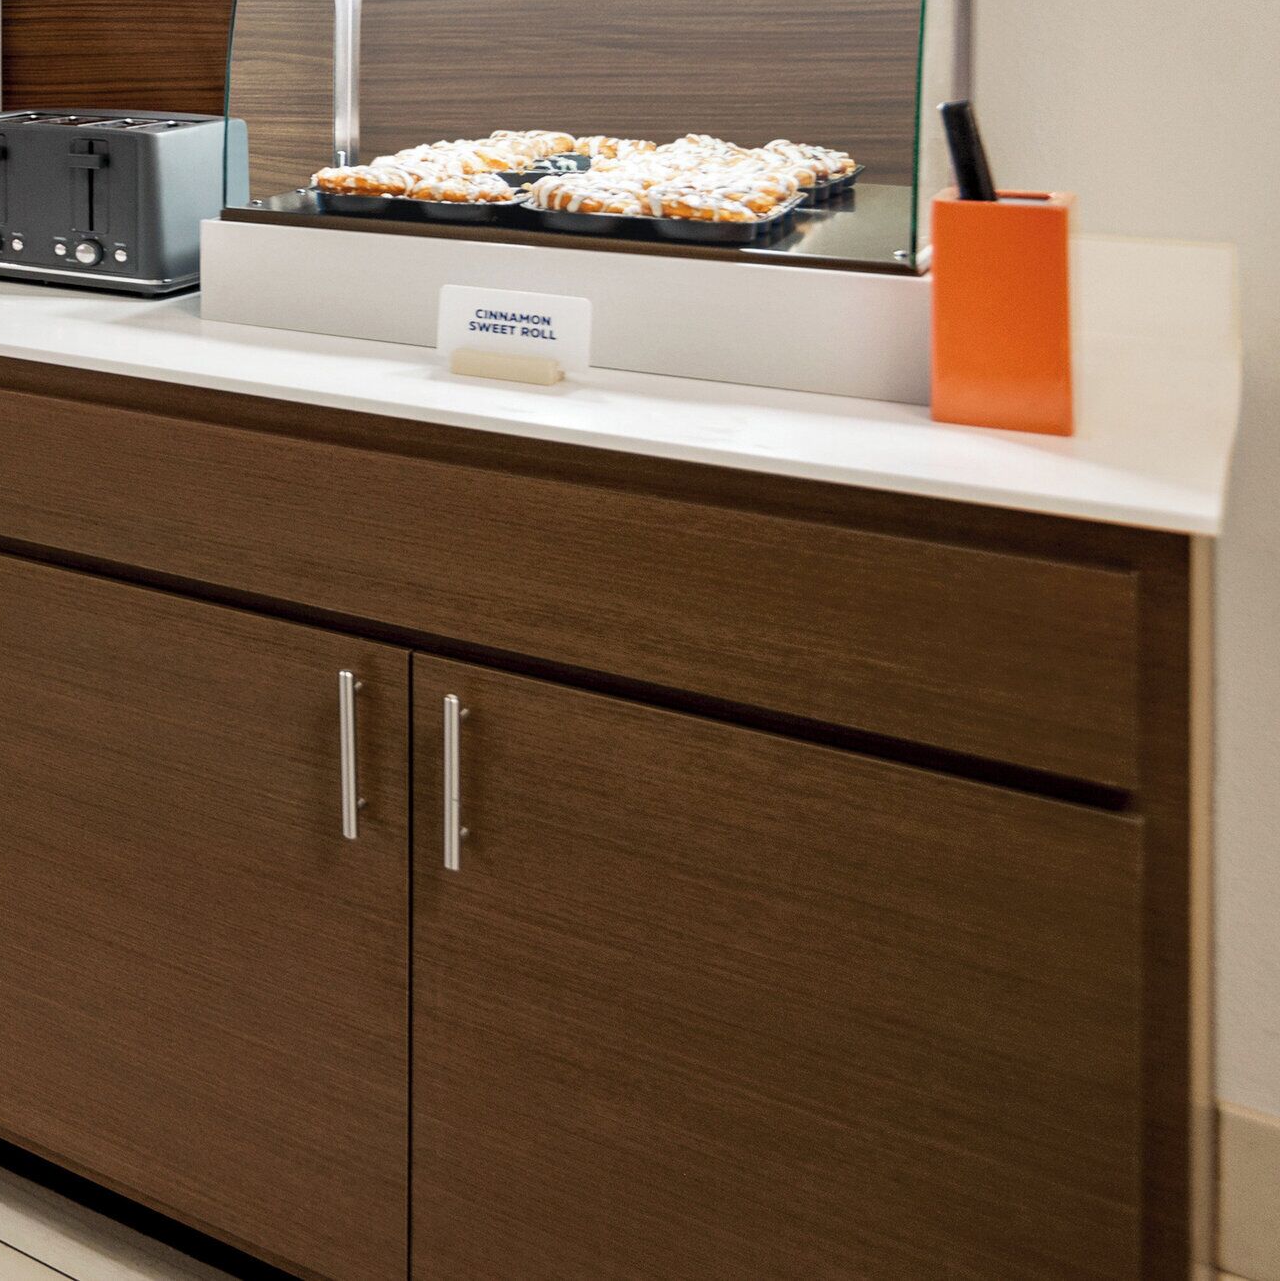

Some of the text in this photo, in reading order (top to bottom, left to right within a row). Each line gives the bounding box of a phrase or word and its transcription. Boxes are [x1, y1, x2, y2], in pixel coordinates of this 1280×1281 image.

[475, 308, 552, 327] CINNAMON
[468, 320, 557, 340] SWEET ROLL
